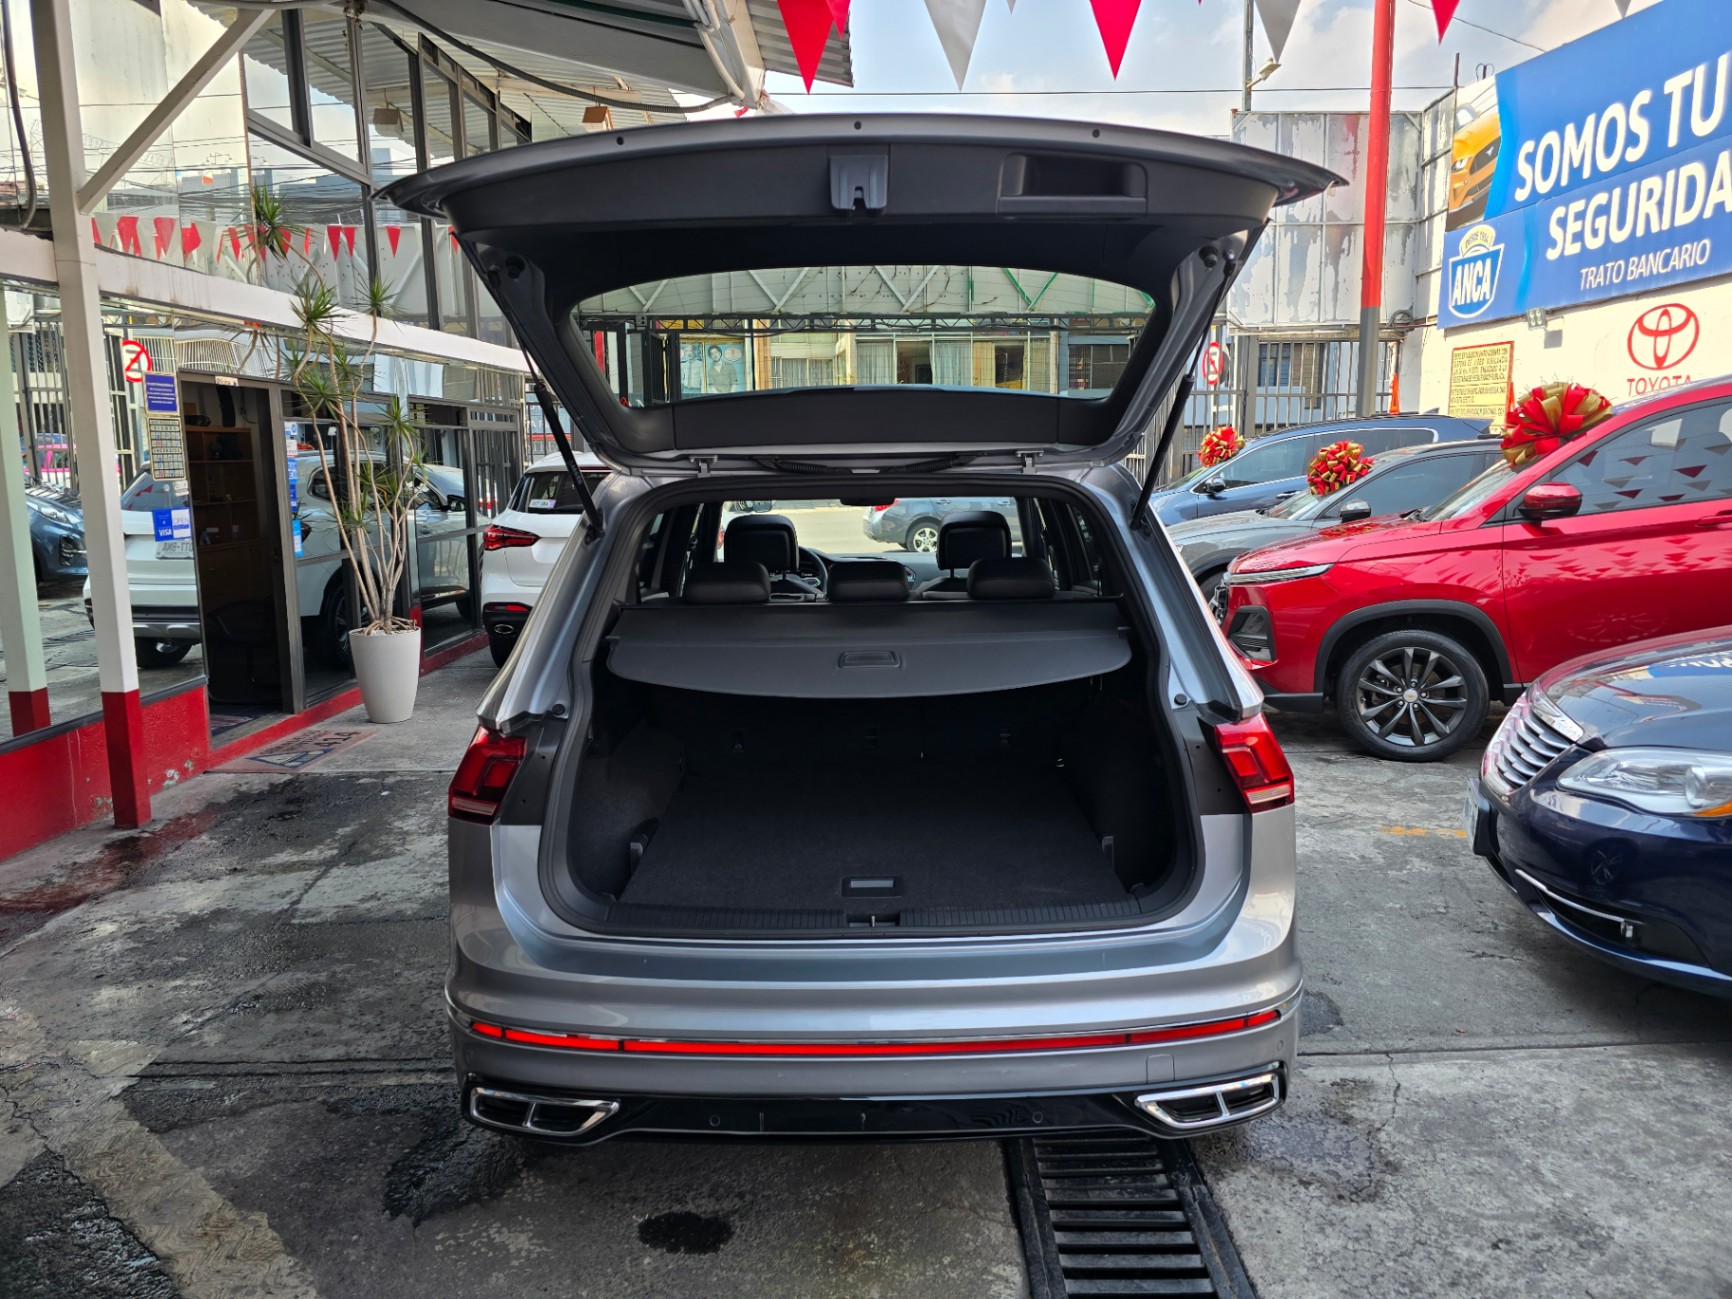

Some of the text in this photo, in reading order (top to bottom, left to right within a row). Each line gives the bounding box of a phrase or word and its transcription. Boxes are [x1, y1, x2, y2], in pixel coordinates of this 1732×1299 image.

[1514, 52, 1731, 202] SOMOS TU
[1451, 258, 1492, 307] ANCA
[1580, 238, 1711, 291] TRATO BANCARIO
[158, 528, 172, 537] VISA
